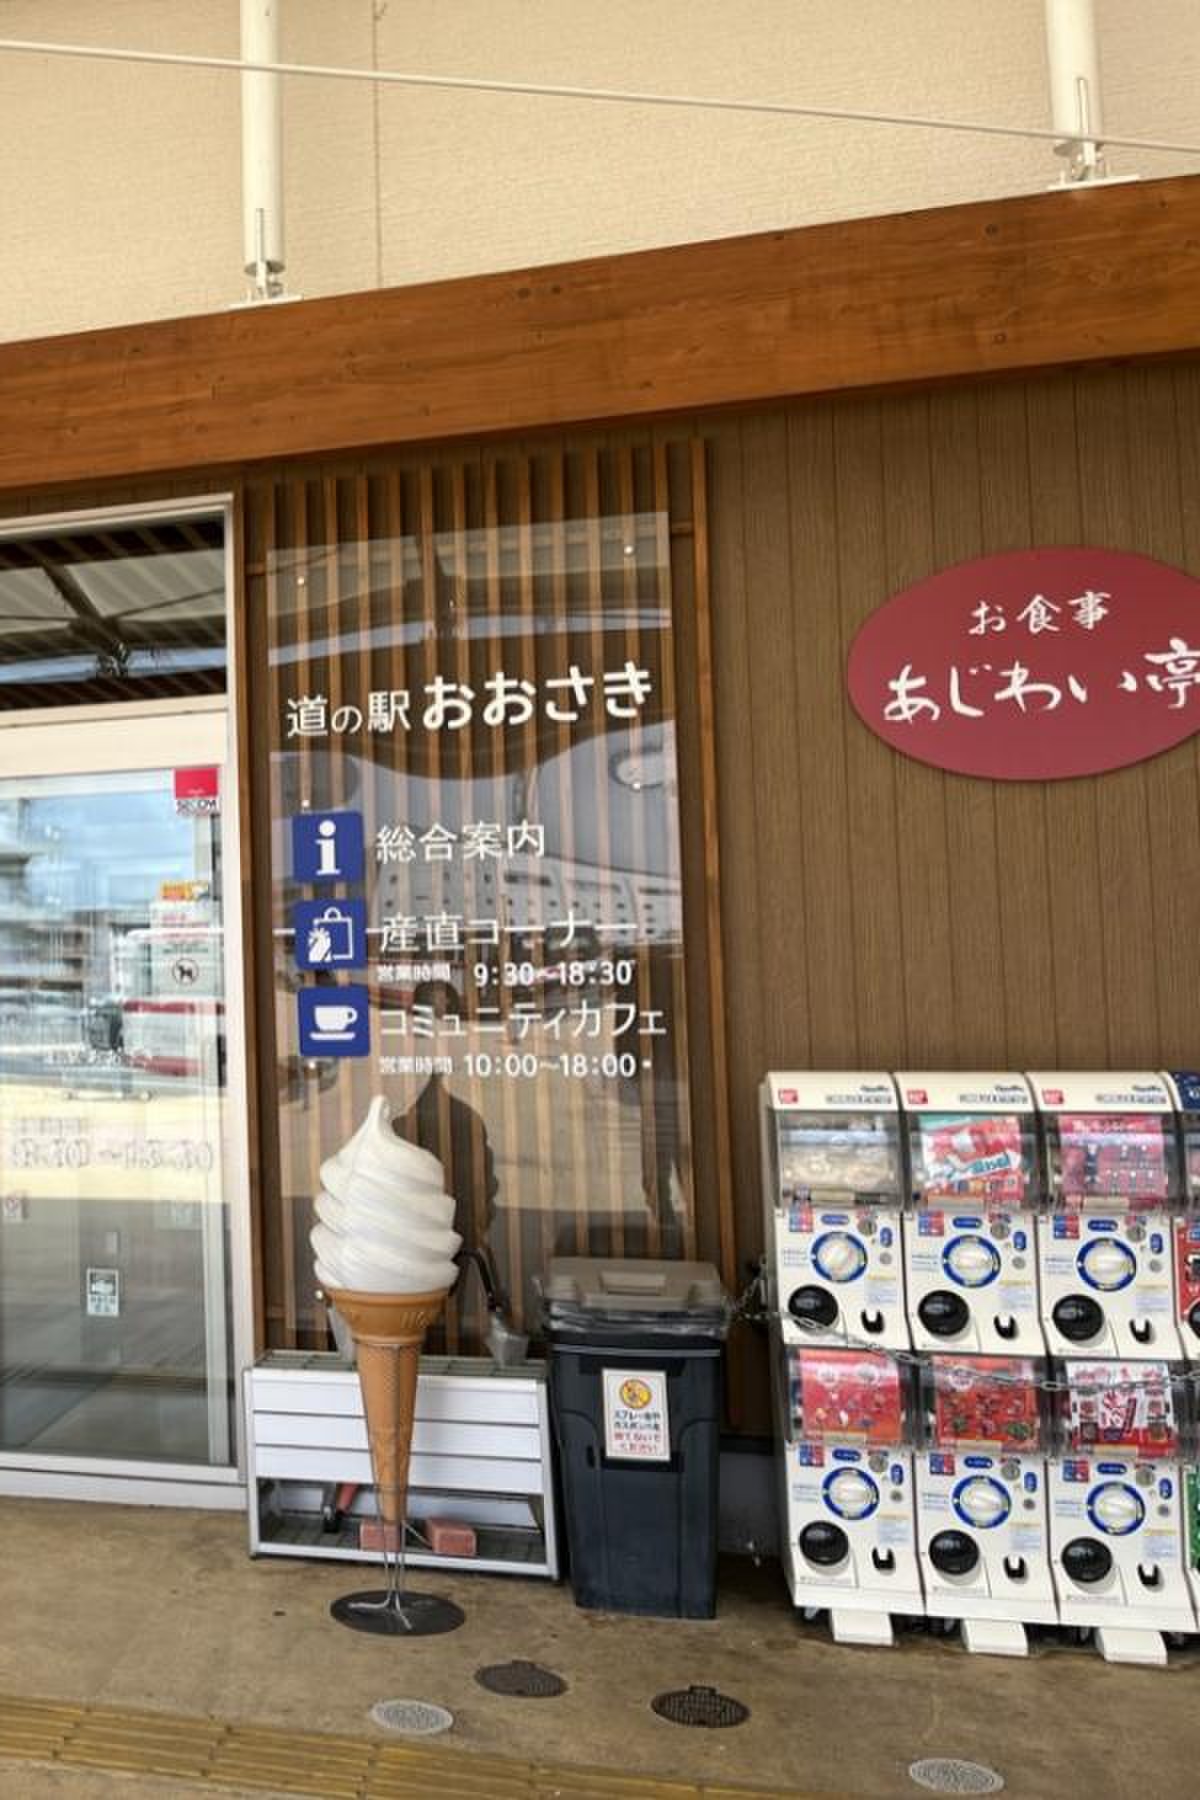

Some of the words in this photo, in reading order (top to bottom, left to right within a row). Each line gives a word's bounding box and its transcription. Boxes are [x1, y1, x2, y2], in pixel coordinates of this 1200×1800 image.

[968, 591, 1111, 635] お食事
[884, 637, 1200, 723] あじわい亭
[376, 823, 545, 864] 総合案内
[379, 910, 637, 953] 産直コーナー
[380, 999, 666, 1040] コミュニティカフェ
